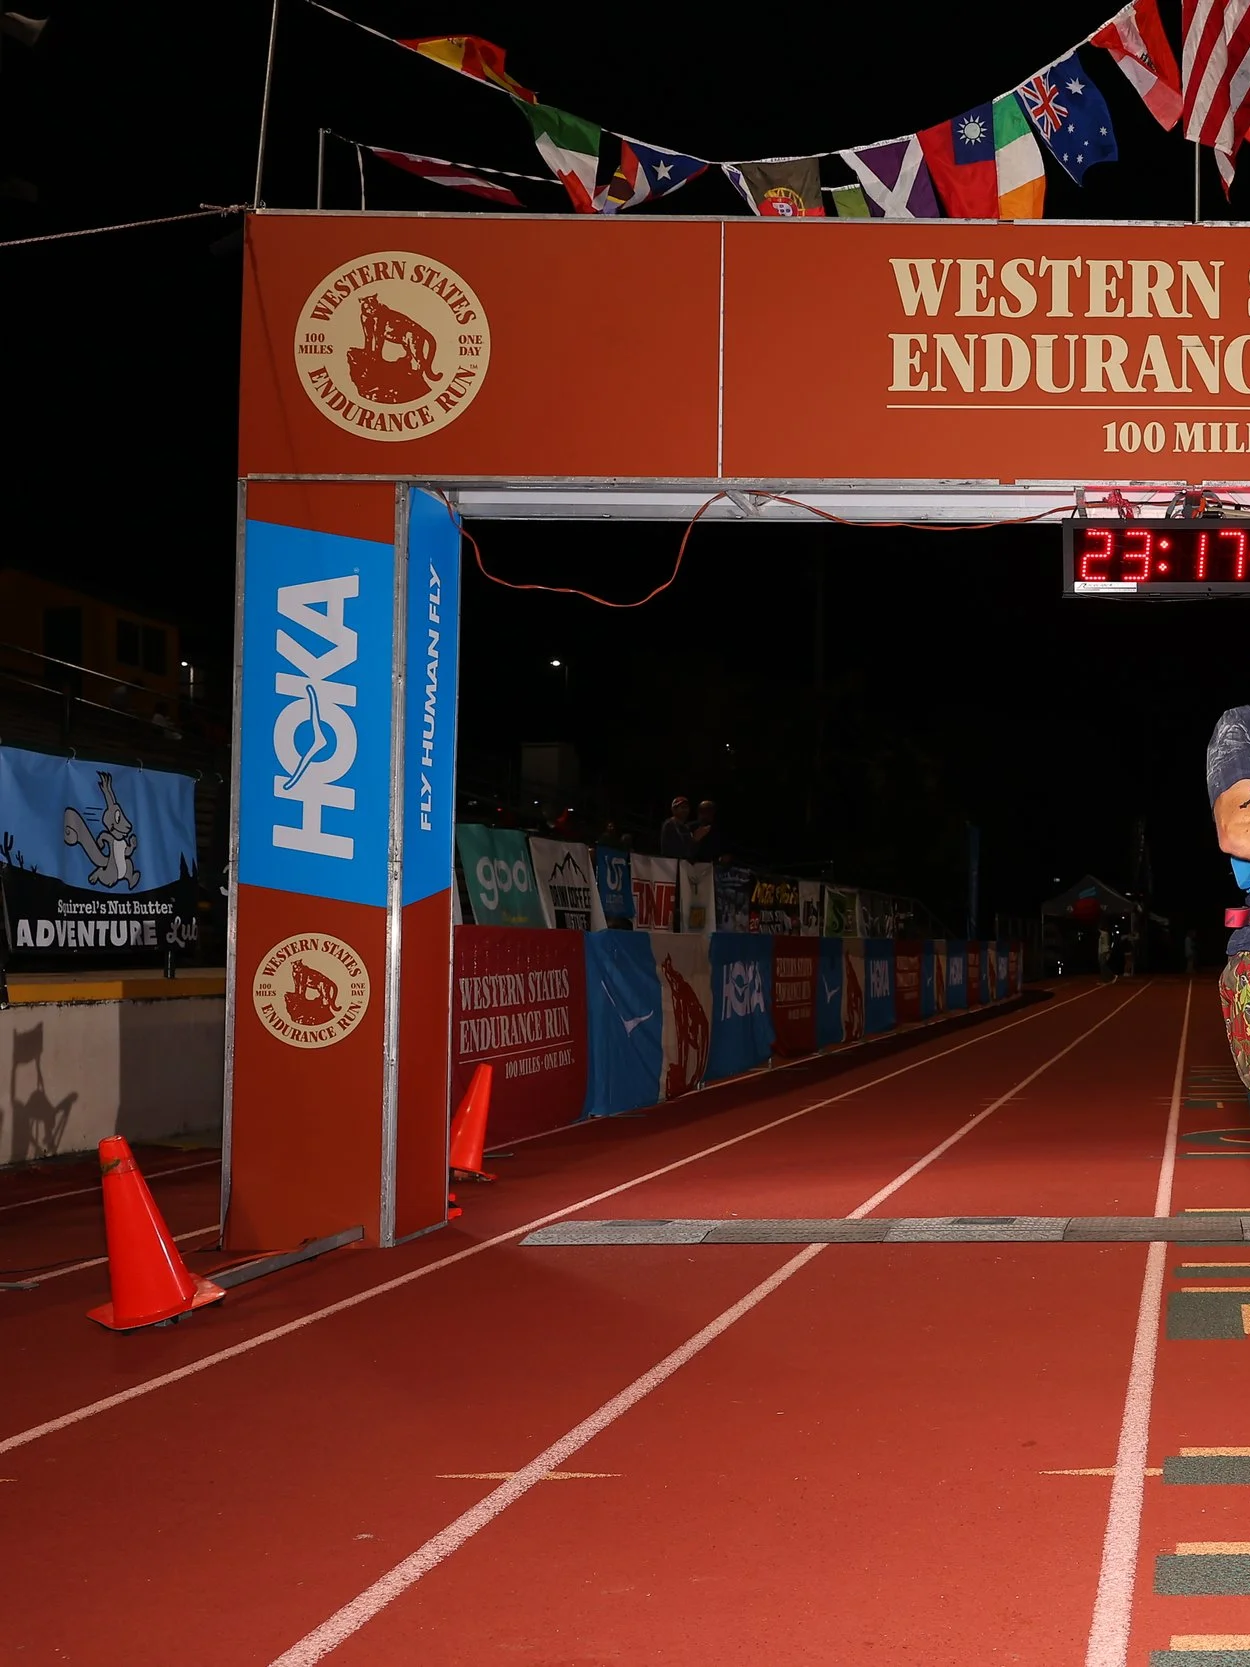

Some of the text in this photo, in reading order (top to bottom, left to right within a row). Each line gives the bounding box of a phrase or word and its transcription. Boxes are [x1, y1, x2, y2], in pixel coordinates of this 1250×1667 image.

[310, 260, 477, 325] WESTERN STATES
[889, 256, 1224, 319] WESTERN
[298, 345, 334, 355] MILES
[305, 333, 325, 343] 100
[458, 335, 483, 345] ONE
[459, 347, 482, 356] DAY
[308, 366, 435, 432] ENDURANCE
[434, 365, 476, 414] RUN
[1102, 421, 1166, 454] 100
[272, 574, 360, 860] HOKA
[420, 563, 442, 831] FLY HUMAN FLY
[57, 899, 173, 917] Squirrel's Nut Butter
[16, 916, 198, 948] ADVENTURE Lub
[262, 938, 362, 978] WESTERN STATES
[459, 968, 570, 1011] WESTERN STATES
[721, 960, 765, 1021] HOKA
[262, 1002, 362, 1042] ENDURANCE RUN
[459, 1006, 570, 1055] ENDURANCE RUN
[505, 1048, 572, 1079] 100 MILES ONE DAY
